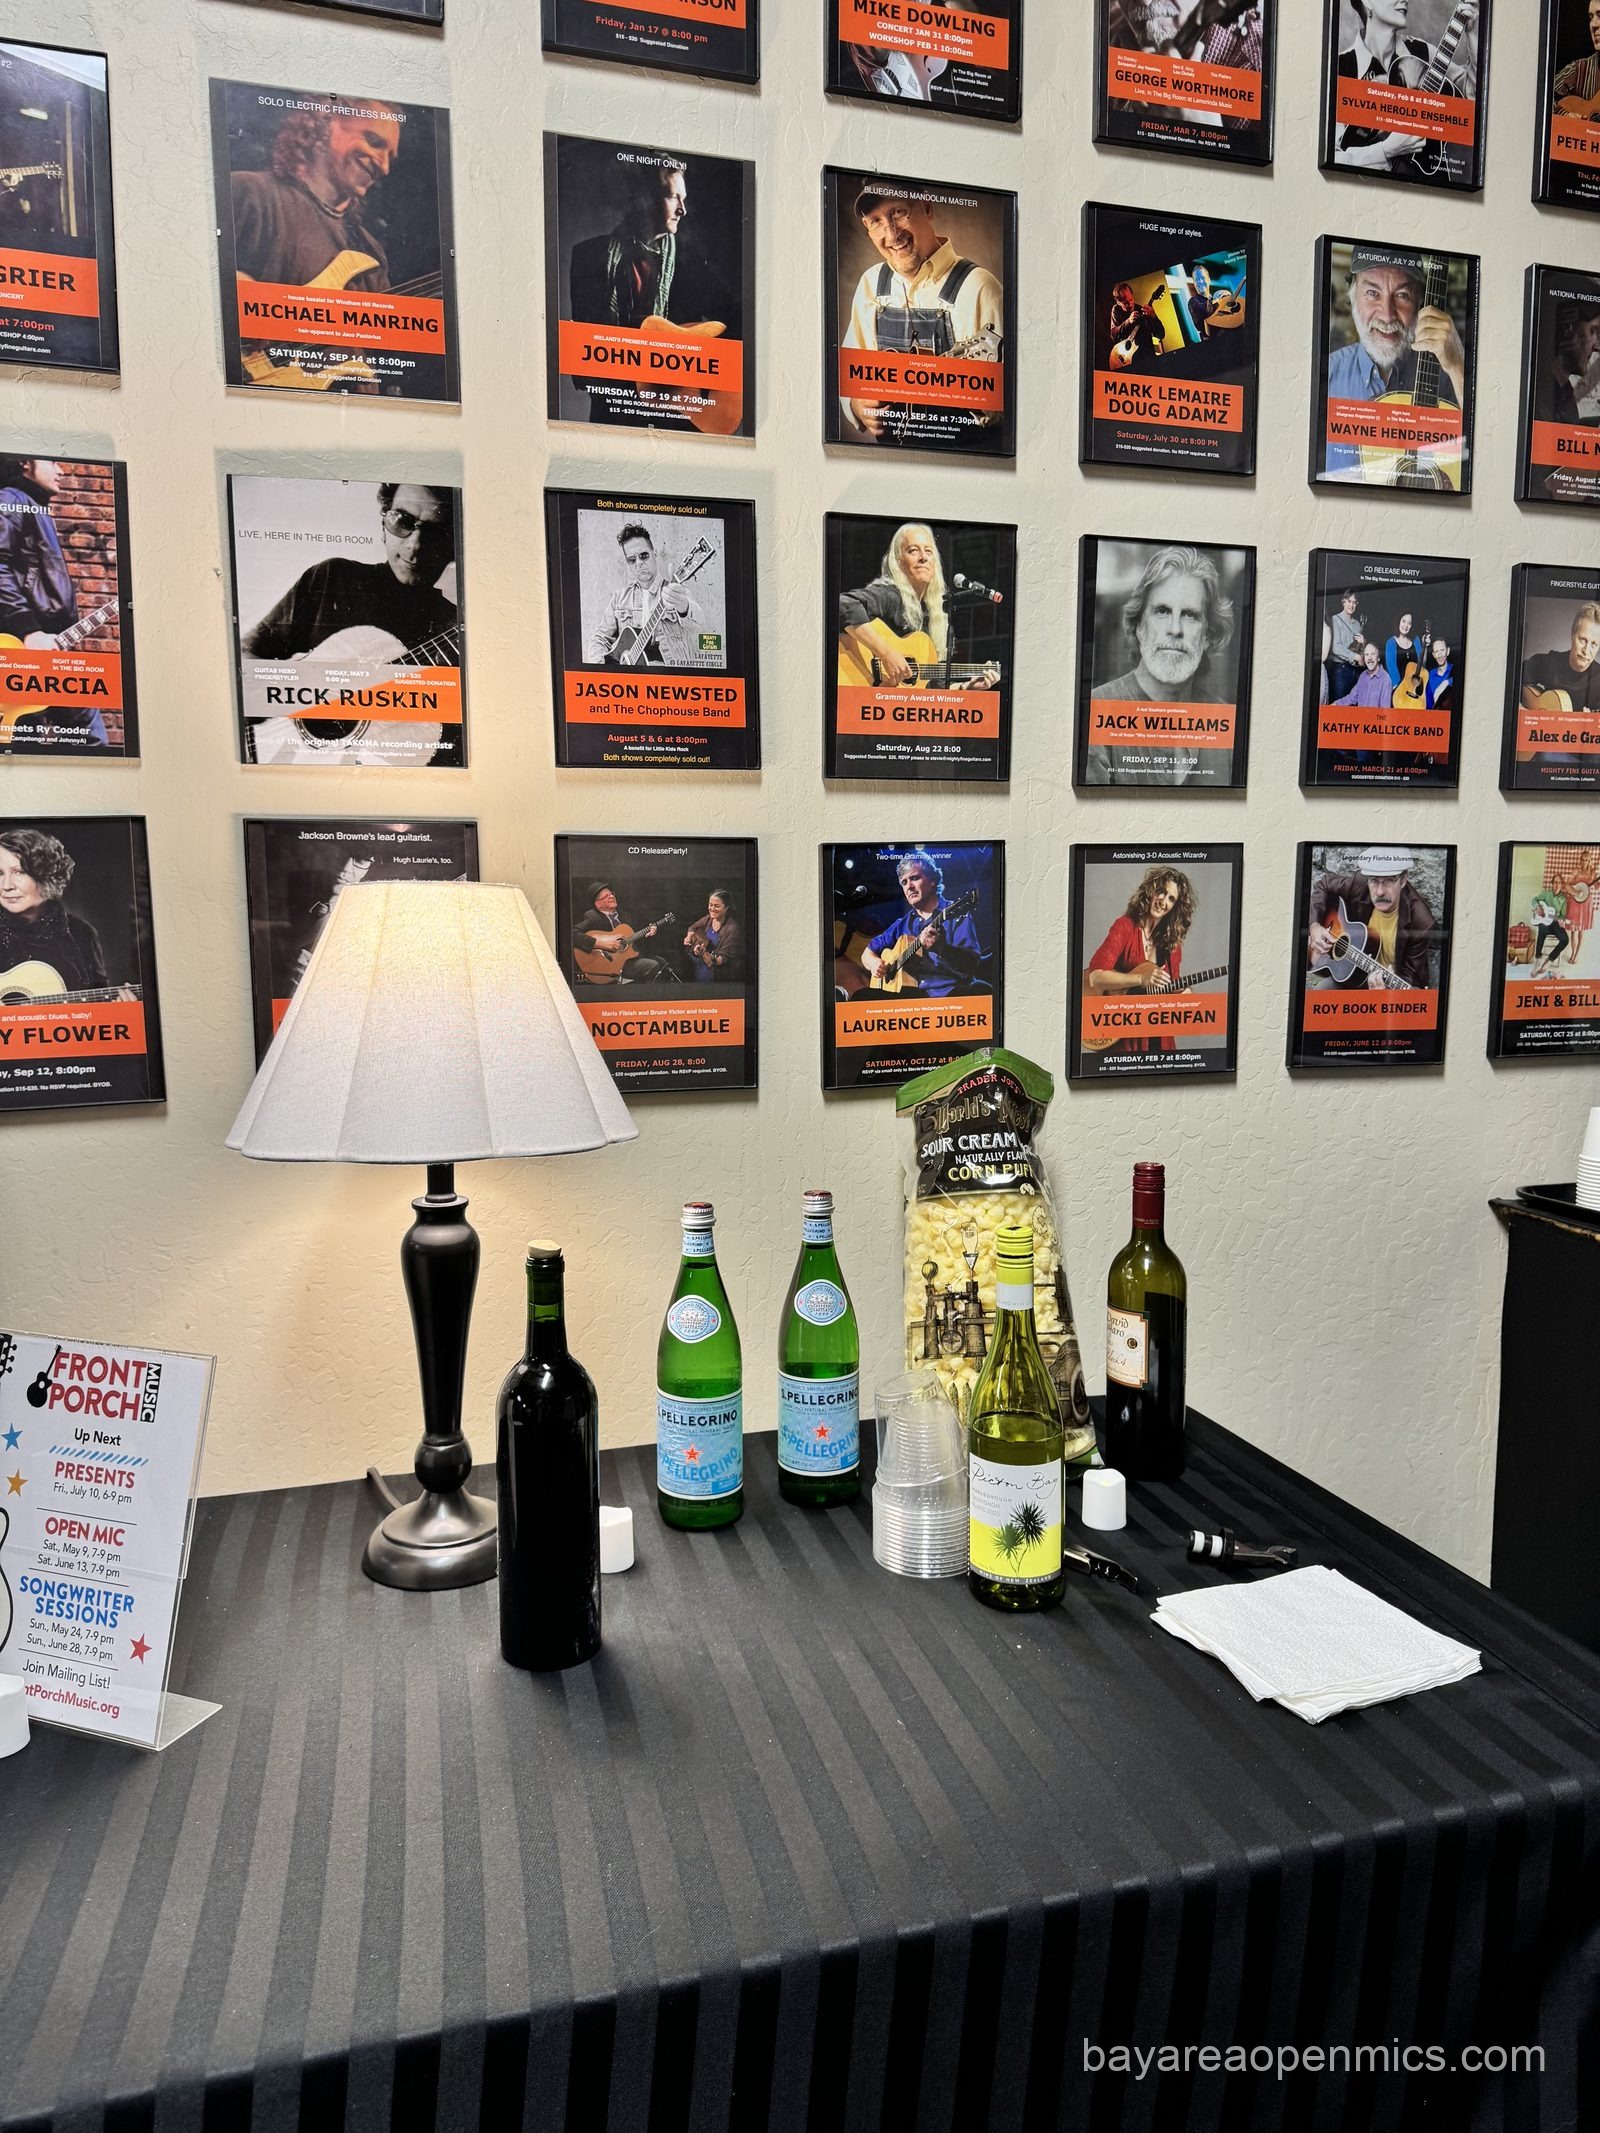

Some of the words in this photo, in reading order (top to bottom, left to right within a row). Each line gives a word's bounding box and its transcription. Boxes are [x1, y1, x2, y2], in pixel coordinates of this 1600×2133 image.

[854, 1, 900, 19] MIKE
[908, 8, 995, 37] DOWLING
[877, 22, 912, 34] CONCERT
[915, 28, 930, 36] JAN
[944, 33, 973, 45] 8:00pm
[869, 32, 915, 46] WORKSHOP
[917, 41, 931, 49] FEB
[940, 45, 973, 57] 10:00am
[1116, 70, 1167, 88] GEORGE
[1172, 79, 1254, 102] WORTHMORE
[258, 96, 284, 107] SOLO
[286, 100, 330, 112] ELECTRIC
[333, 106, 378, 119] FRETLESS
[380, 111, 407, 122] BASS!
[1342, 97, 1377, 111] SYLVIA
[1380, 104, 1418, 118] HEROLD
[1421, 111, 1469, 127] ENSEMBLE
[1557, 135, 1587, 151] PETE
[617, 153, 635, 162] ONE
[636, 155, 661, 165] NIGHT
[663, 159, 687, 170] ONLY!
[864, 186, 908, 198] BLUEGRASS
[910, 191, 947, 203] MANDOLIN
[948, 197, 977, 207] MASTER
[1140, 223, 1158, 232] HUGE
[1160, 226, 1176, 235] range
[1185, 228, 1203, 238] styles.
[244, 302, 336, 324] MICHAEL
[343, 311, 438, 332] MANRING
[269, 348, 327, 361] SATURDAY,
[330, 354, 348, 362] SEP
[352, 355, 363, 364] 14
[378, 356, 416, 368] 8:00pm
[582, 345, 641, 367] JOHN
[650, 352, 720, 375] DOYLE
[849, 364, 897, 383] MIKE
[904, 370, 995, 392] COMPTON
[1105, 380, 1152, 399] MARK
[1158, 386, 1231, 407] LEMAIRE
[1109, 399, 1160, 417] DOUG
[1166, 405, 1228, 424] ADAMZ
[1331, 422, 1377, 437] WAYNE
[1381, 428, 1457, 444] HENDERSON
[1557, 439, 1589, 455] BILL
[239, 530, 262, 540] LIVE,
[265, 531, 290, 540] HERE
[293, 532, 302, 541] IN
[304, 533, 323, 541] THE
[326, 534, 342, 543] BIG
[345, 536, 373, 545] ROOM
[1374, 567, 1399, 575] RELEASE
[1401, 568, 1420, 576] PARTY
[6, 675, 109, 696] GARCIA
[575, 683, 638, 699] JASON
[646, 686, 738, 702] NEWSTED
[267, 687, 330, 706] RICK
[340, 689, 438, 710] RUSKIN
[876, 693, 908, 703] Grammy
[911, 694, 935, 702] Award
[589, 704, 610, 713] and
[613, 705, 634, 714] The
[637, 706, 700, 718] Chophouse
[703, 707, 730, 717] Band
[861, 706, 885, 721] ED
[892, 707, 984, 724] GERHARD
[1, 724, 33, 733] meets
[36, 724, 50, 735] Ry
[53, 725, 90, 735] Cooder
[1096, 715, 1138, 730] JACK
[1145, 717, 1229, 732] WILLIAMS
[1322, 723, 1360, 735] KATHY
[1363, 725, 1410, 736] KALLICK
[1414, 726, 1444, 737] BAND
[1529, 729, 1559, 742] Alex
[1562, 731, 1577, 743] de
[299, 832, 334, 841] Jackson
[337, 832, 375, 841] Browne's
[378, 832, 395, 841] lead
[397, 832, 432, 843] guitarist.
[394, 856, 411, 864] Hugh
[413, 856, 439, 864] Laurie's,
[641, 847, 688, 855] ReleaseParty!
[1113, 852, 1145, 860] Astonishing
[1183, 852, 1207, 860] Wizardry
[2, 1014, 16, 1022] and
[49, 1013, 70, 1021] blues,
[72, 1012, 92, 1020] baby!
[1313, 1005, 1339, 1014] ROY
[1342, 1005, 1376, 1014] BOOK
[1381, 1003, 1427, 1013] BINDER
[592, 1018, 730, 1038] NOCTAMBULE
[843, 1017, 930, 1033] LAURENCE
[936, 1014, 987, 1028] JUBER
[1091, 1013, 1142, 1027] VICKI
[1148, 1011, 1216, 1025] GENFAN
[23, 1024, 131, 1045] FLOWER
[957, 1074, 998, 1095] TRADER
[1001, 1075, 1020, 1094] JOE'S
[921, 1138, 954, 1158] SOUR
[958, 1132, 1018, 1151] CREAM
[955, 1152, 1004, 1164] NATURALLY
[948, 1164, 995, 1182] CORN
[54, 1352, 147, 1388] FRONT
[49, 1383, 141, 1421] PORCH
[141, 1363, 161, 1422] MUSIC
[781, 1387, 859, 1406] S.PELLEGRINO
[74, 1428, 89, 1444] Up
[93, 1431, 121, 1446] Next
[55, 1461, 135, 1489] PRESENTS
[972, 1462, 1023, 1490] Picton
[1026, 1472, 1058, 1499] Bay
[54, 1482, 69, 1495] Fri.,
[70, 1485, 87, 1496] July
[89, 1489, 101, 1500] 10,
[103, 1490, 116, 1500] 6-9
[118, 1495, 132, 1505] pm
[45, 1517, 90, 1540] OPEN
[92, 1524, 125, 1546] MIC
[20, 1576, 135, 1613] SONGWRITER
[35, 1597, 119, 1629] SESSIONS
[23, 1659, 45, 1675] Join
[47, 1664, 86, 1687] Mailing
[89, 1673, 111, 1689] List!
